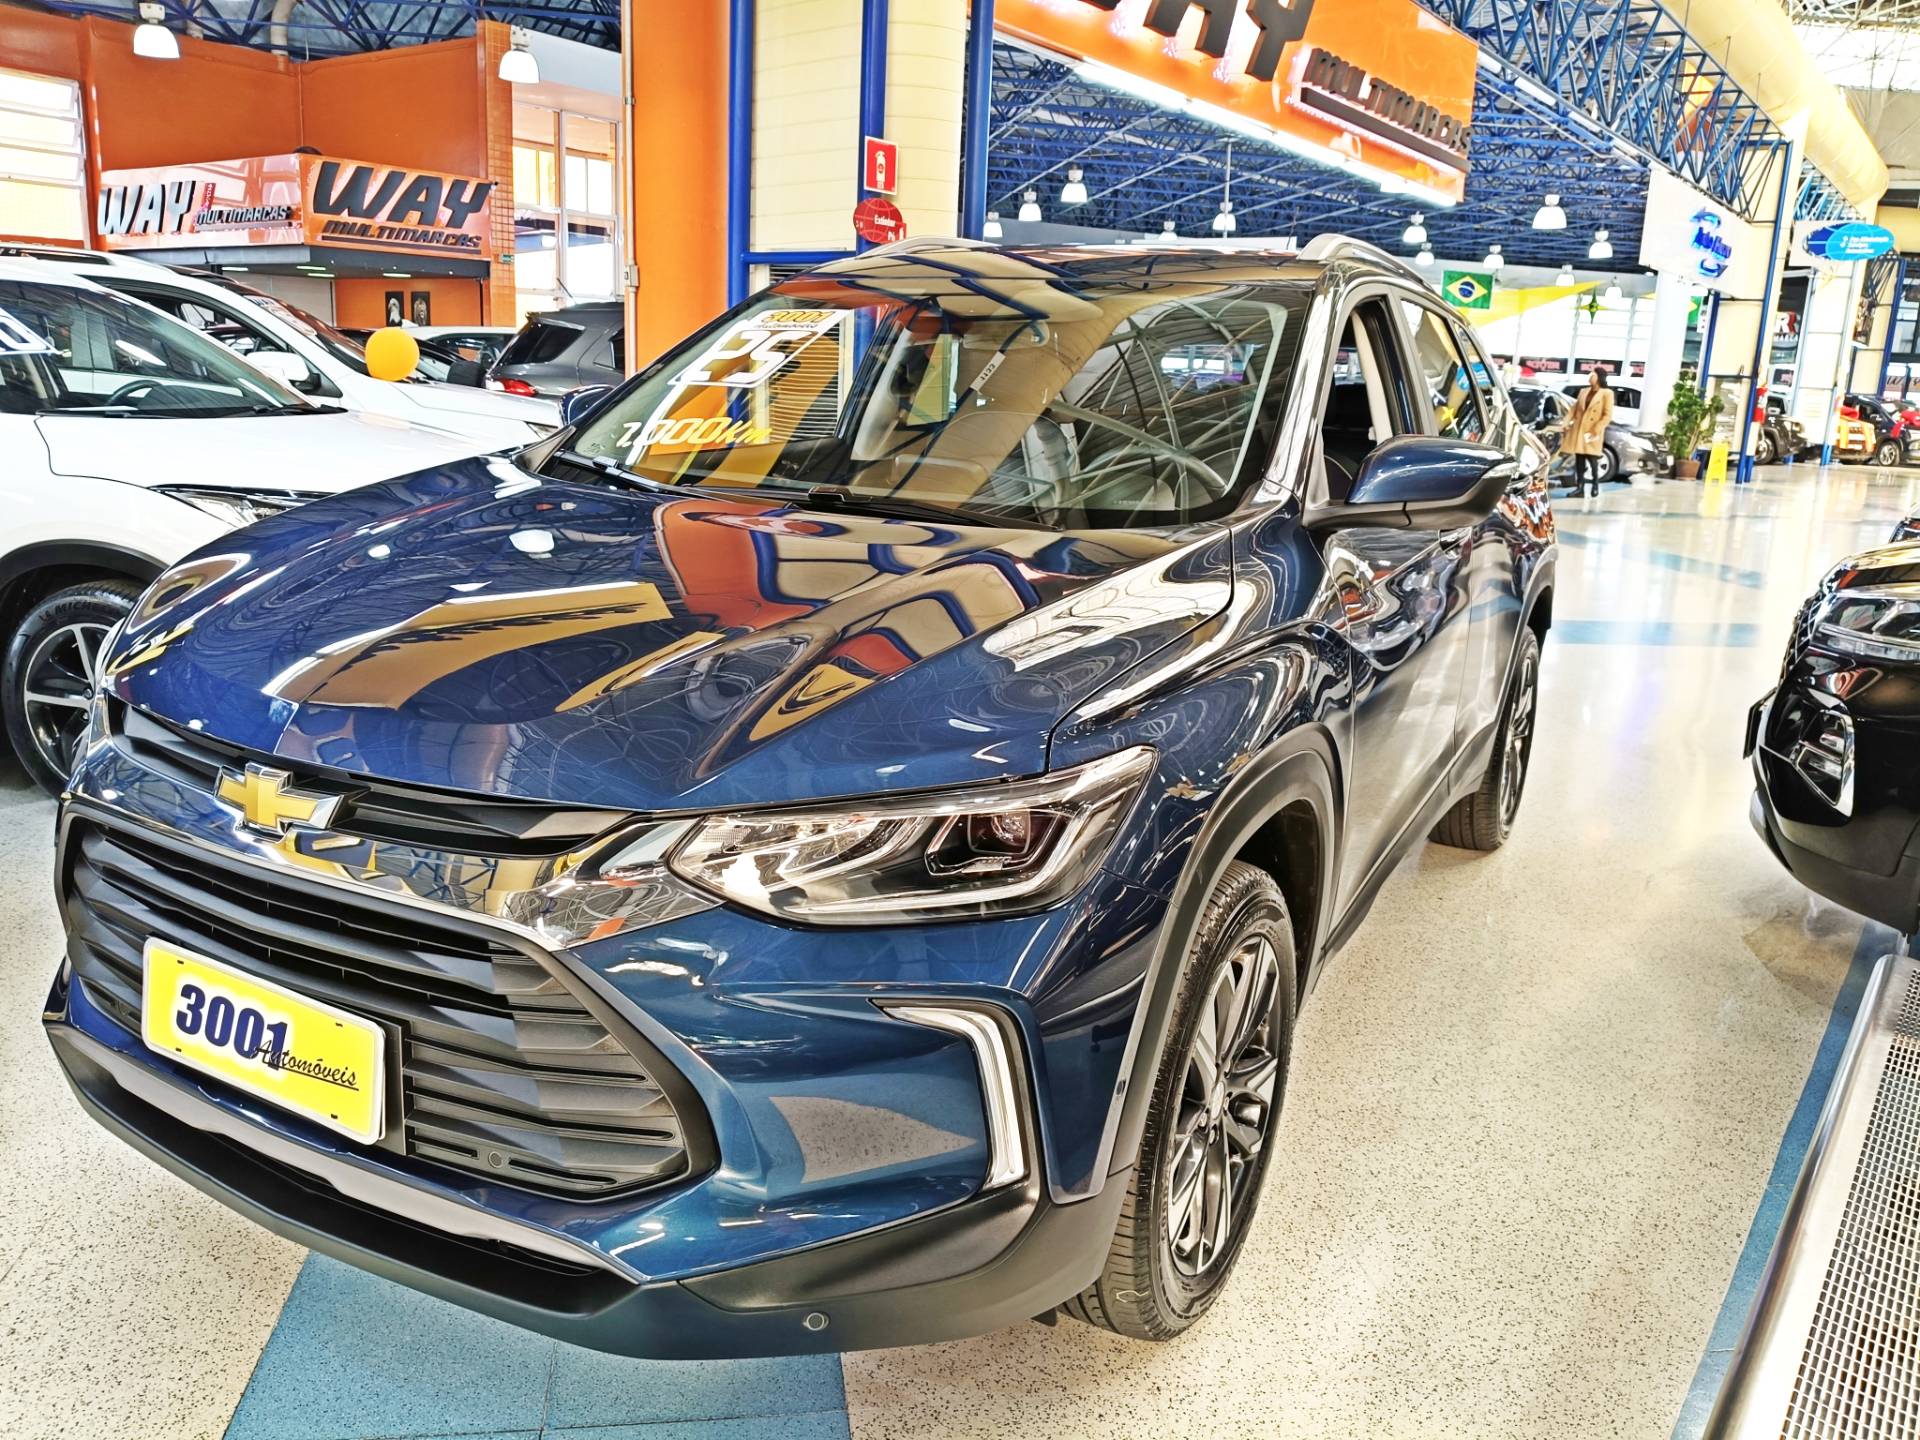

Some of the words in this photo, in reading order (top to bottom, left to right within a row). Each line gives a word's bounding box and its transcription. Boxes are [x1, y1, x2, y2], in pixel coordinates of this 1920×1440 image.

[1302, 48, 1474, 154] MULTIMARCAS
[98, 180, 196, 234] WAY
[196, 206, 292, 225] MULTIMARCAS
[313, 161, 492, 228] WAY
[322, 219, 482, 247] MULTIMARCAS
[176, 983, 288, 1071] 3001
[255, 1039, 359, 1091] Automóveis
